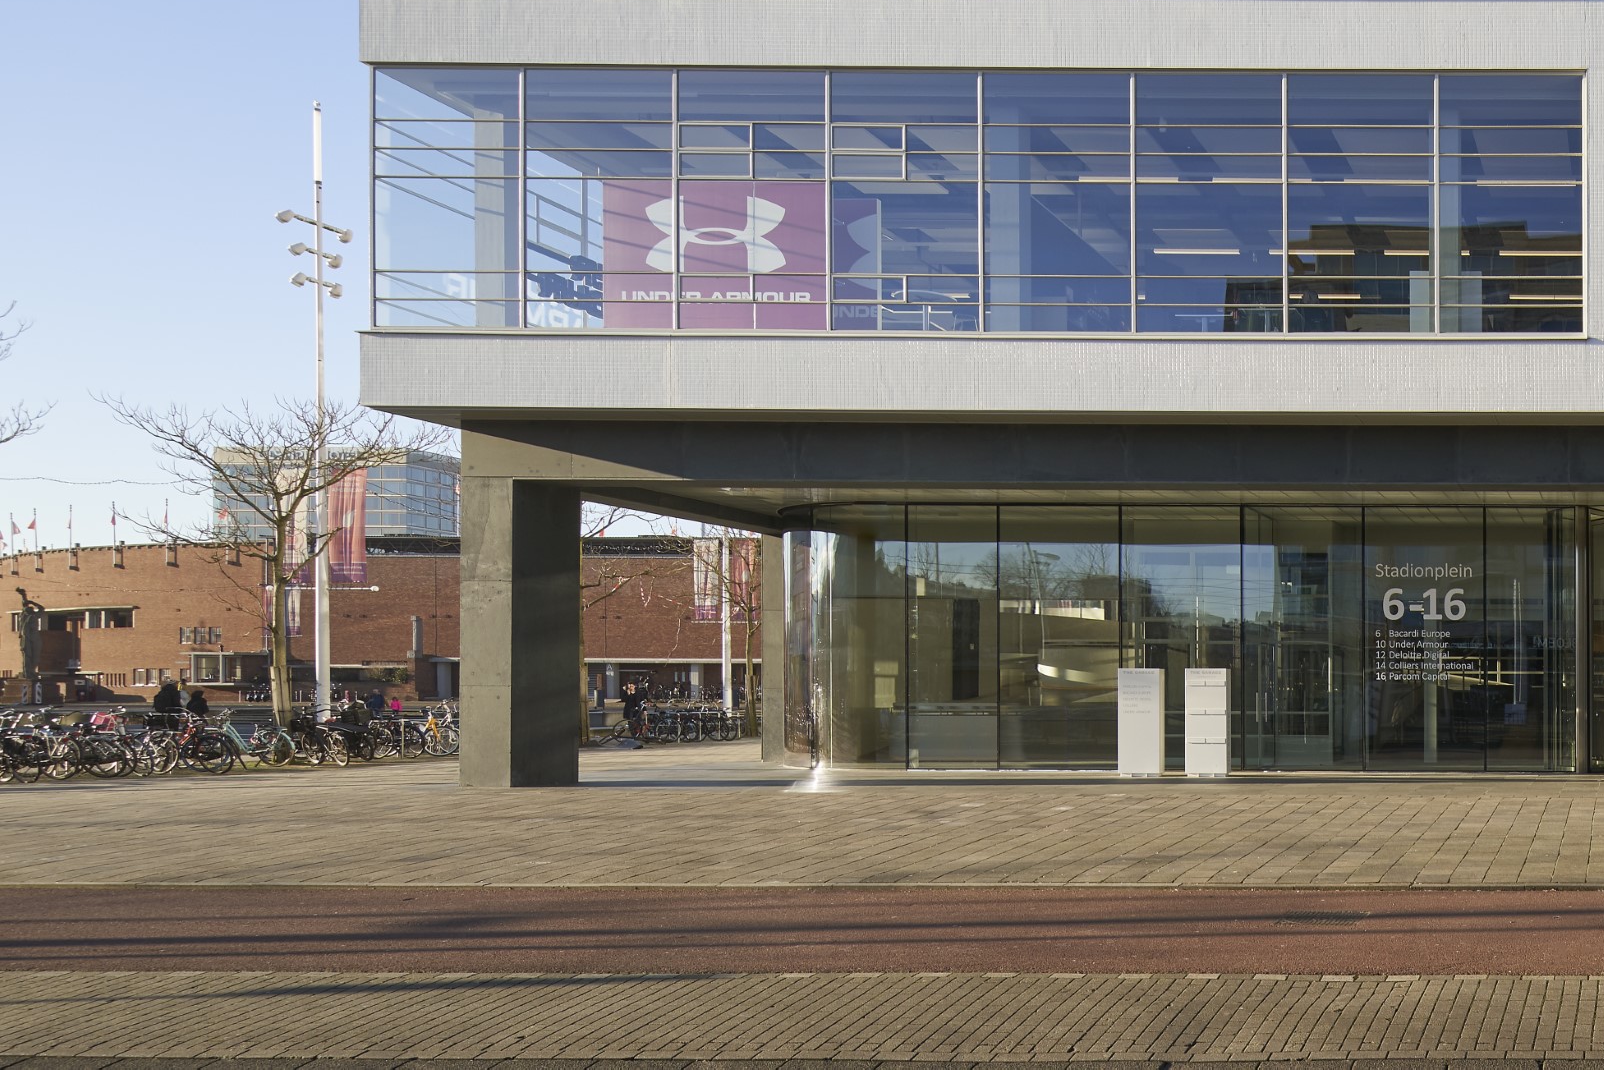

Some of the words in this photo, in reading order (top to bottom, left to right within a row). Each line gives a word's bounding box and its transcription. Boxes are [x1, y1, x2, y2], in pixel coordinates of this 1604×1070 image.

[621, 290, 702, 305] UNDR
[1375, 563, 1473, 581] Stadionplein
[1382, 587, 1467, 621] 6-16
[1375, 629, 1381, 638] 6
[1389, 629, 1419, 638] Bacardi
[1421, 629, 1451, 640] Europe
[1375, 640, 1386, 649] 10
[1389, 640, 1415, 649] Under
[1417, 640, 1449, 649] Armour
[1375, 650, 1386, 659] 12
[1389, 650, 1421, 659] Deloitte
[1423, 650, 1450, 661] Digital
[1375, 661, 1386, 670] 14
[1389, 661, 1419, 670] Colliers
[1421, 661, 1474, 670] International
[1375, 672, 1386, 681] 16
[1389, 672, 1420, 681] Parcom
